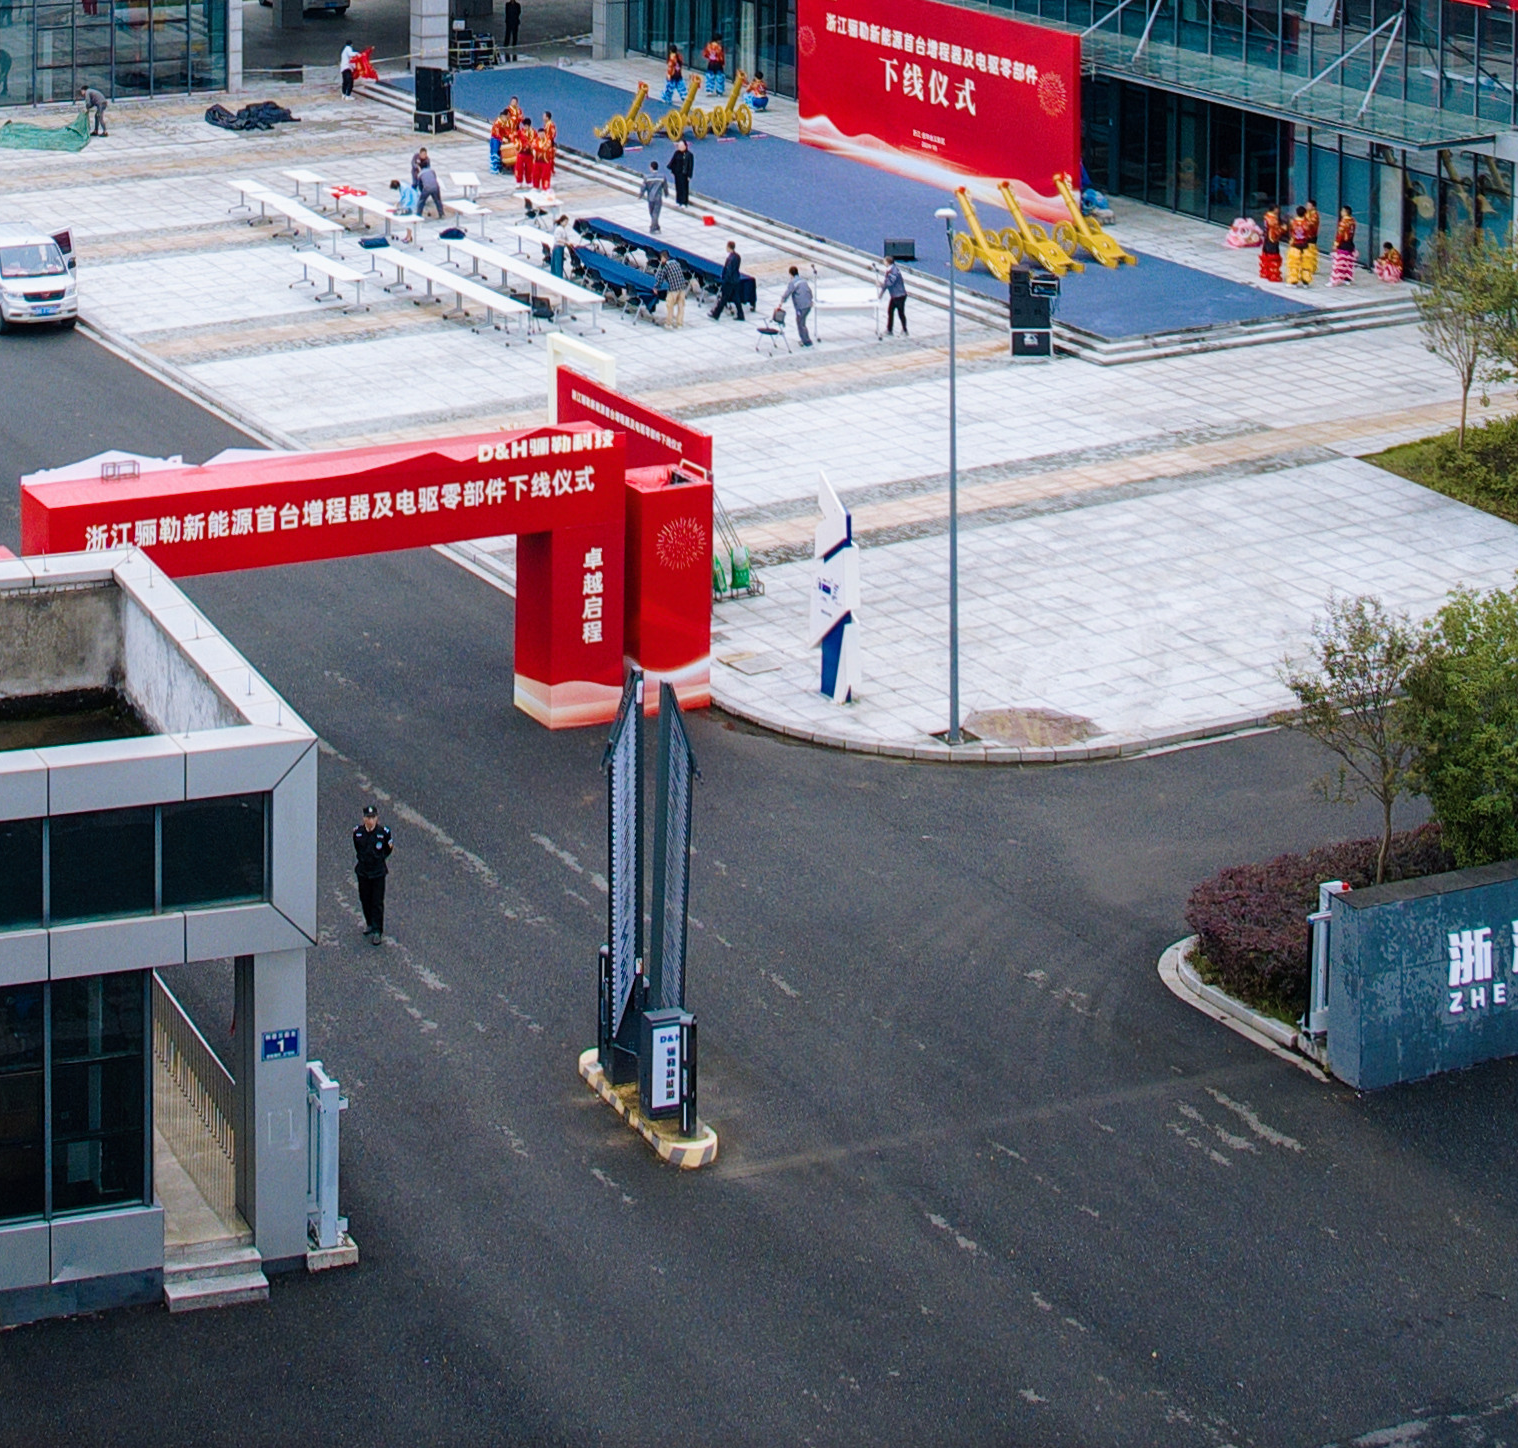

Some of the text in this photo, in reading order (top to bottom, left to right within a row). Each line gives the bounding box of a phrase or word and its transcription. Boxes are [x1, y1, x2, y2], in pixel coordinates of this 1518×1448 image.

[825, 12, 1039, 86] 浙江骊勒新能源首台增程器及电驱零部件
[878, 56, 978, 117] 下线仪式
[84, 464, 596, 553] 浙江骊勒新能源首台增程器及电驱零部件下线仪式
[582, 547, 604, 645] 卓越启程
[1448, 982, 1507, 1014] ZHE
[276, 1038, 285, 1053] 1
